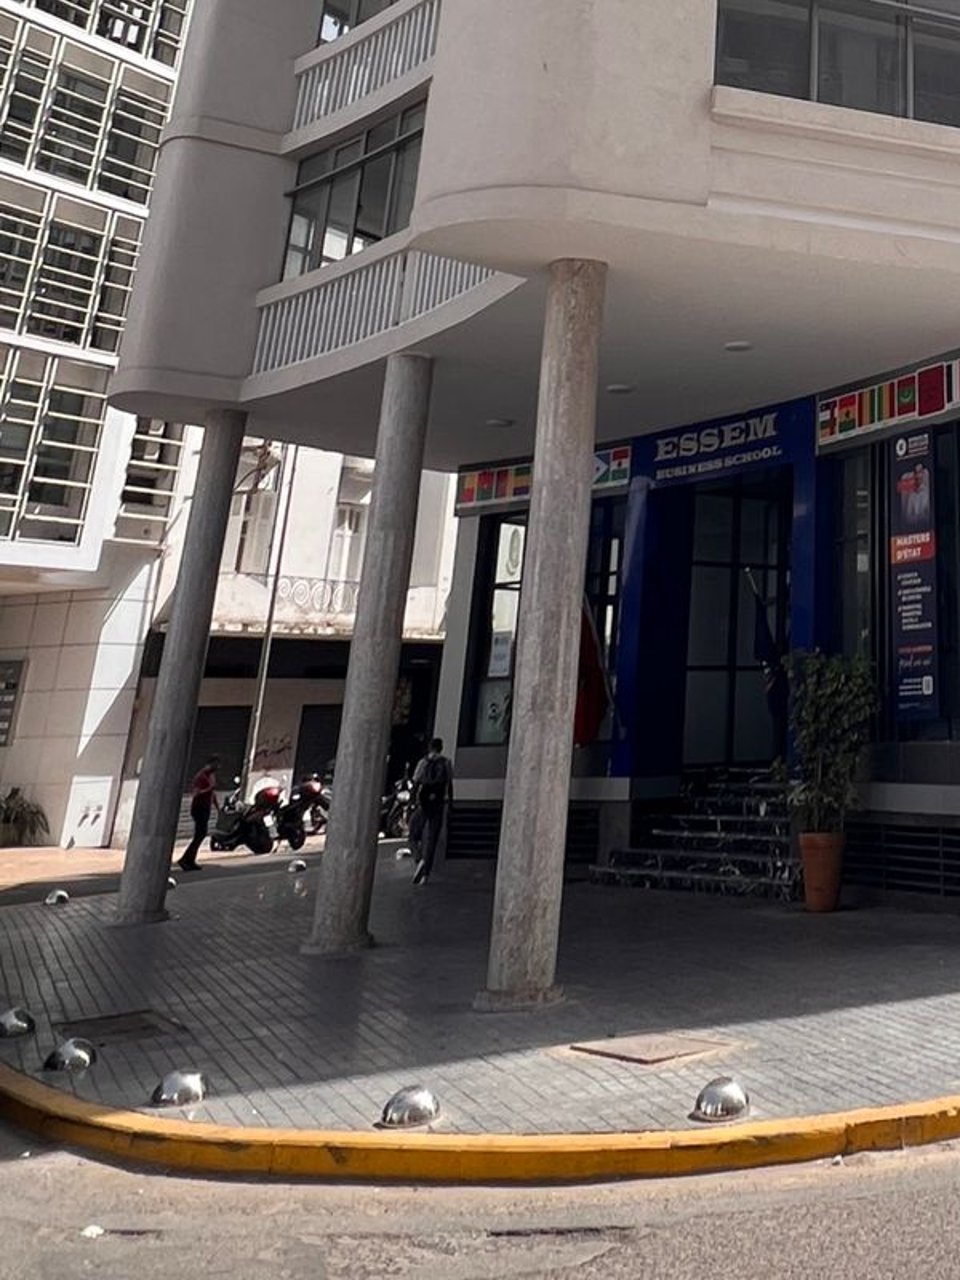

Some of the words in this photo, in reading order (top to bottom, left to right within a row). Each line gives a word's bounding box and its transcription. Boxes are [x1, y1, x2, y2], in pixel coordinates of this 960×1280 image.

[653, 412, 779, 462] ESSEM
[655, 458, 723, 480] BUSINESS
[724, 445, 783, 468] SCHOOL
